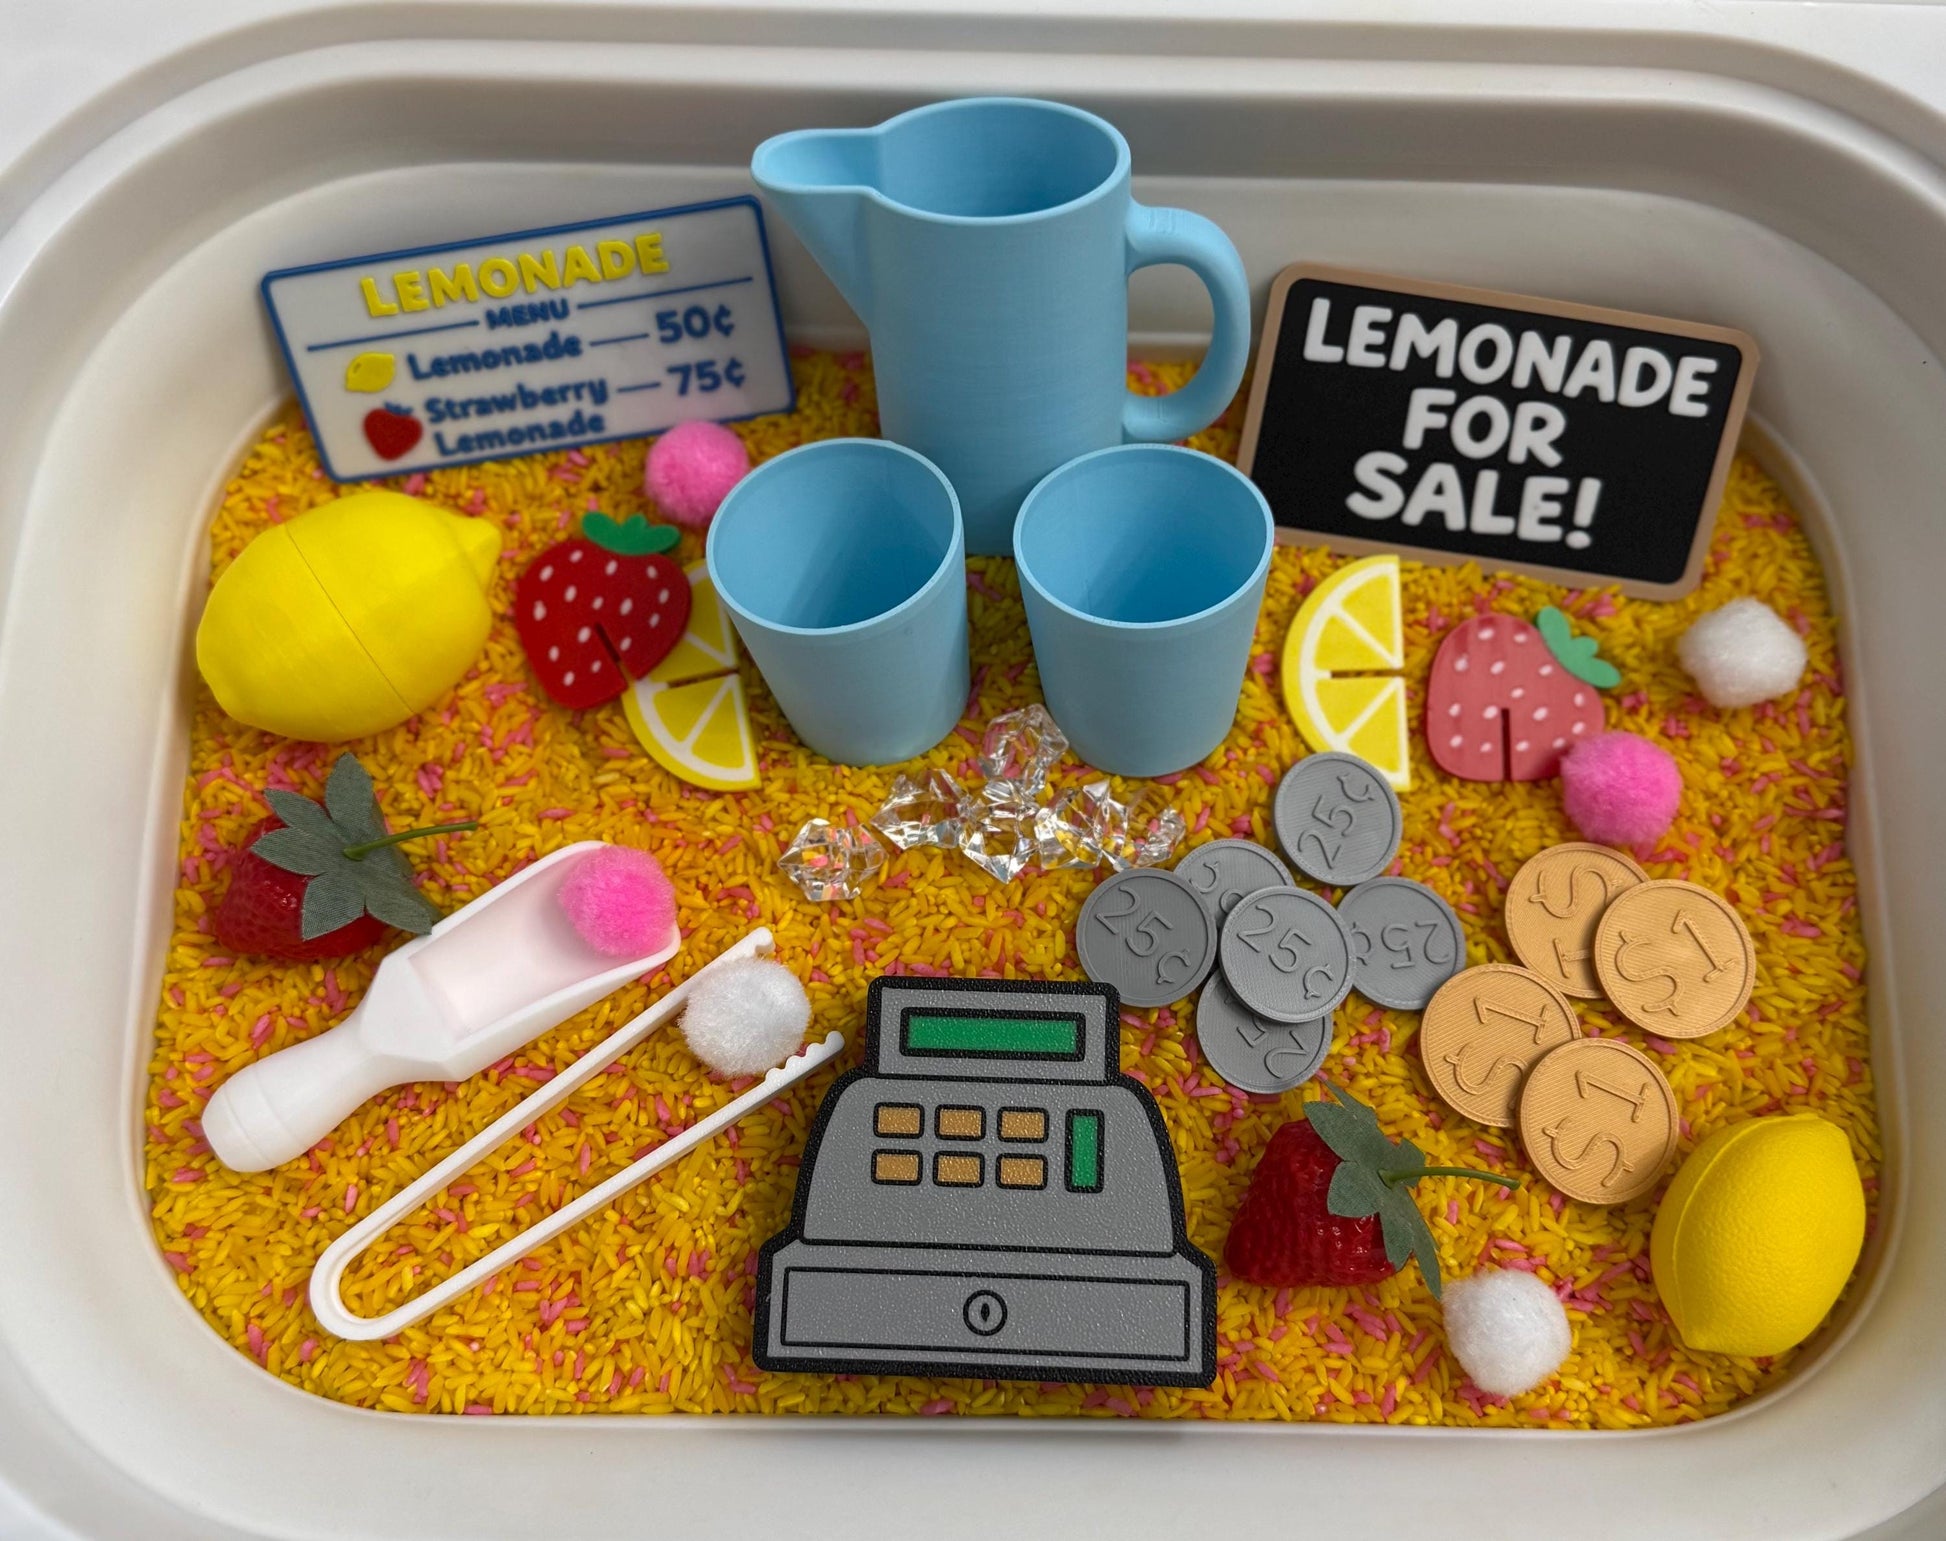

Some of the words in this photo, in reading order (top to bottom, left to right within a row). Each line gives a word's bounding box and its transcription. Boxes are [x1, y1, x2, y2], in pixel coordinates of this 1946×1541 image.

[360, 233, 670, 318] LEMONADE
[486, 298, 570, 330] MENU
[406, 330, 583, 381] Lemonade
[654, 304, 736, 346] 50¢
[424, 377, 609, 424] Strawberry
[665, 357, 747, 397] 75¢
[1302, 297, 1719, 418] LEMONADE
[433, 409, 607, 457] Lemonade
[1402, 387, 1567, 468] FOR
[1344, 450, 1602, 550] SALE!
[1297, 772, 1376, 870] 25¢
[1095, 886, 1192, 985] 25¢
[1236, 904, 1335, 1000] 25¢
[1614, 909, 1737, 1017] $1
[1235, 1014, 1309, 1080] 25
[1443, 995, 1549, 1109] $1
[1542, 1069, 1650, 1188] $1
